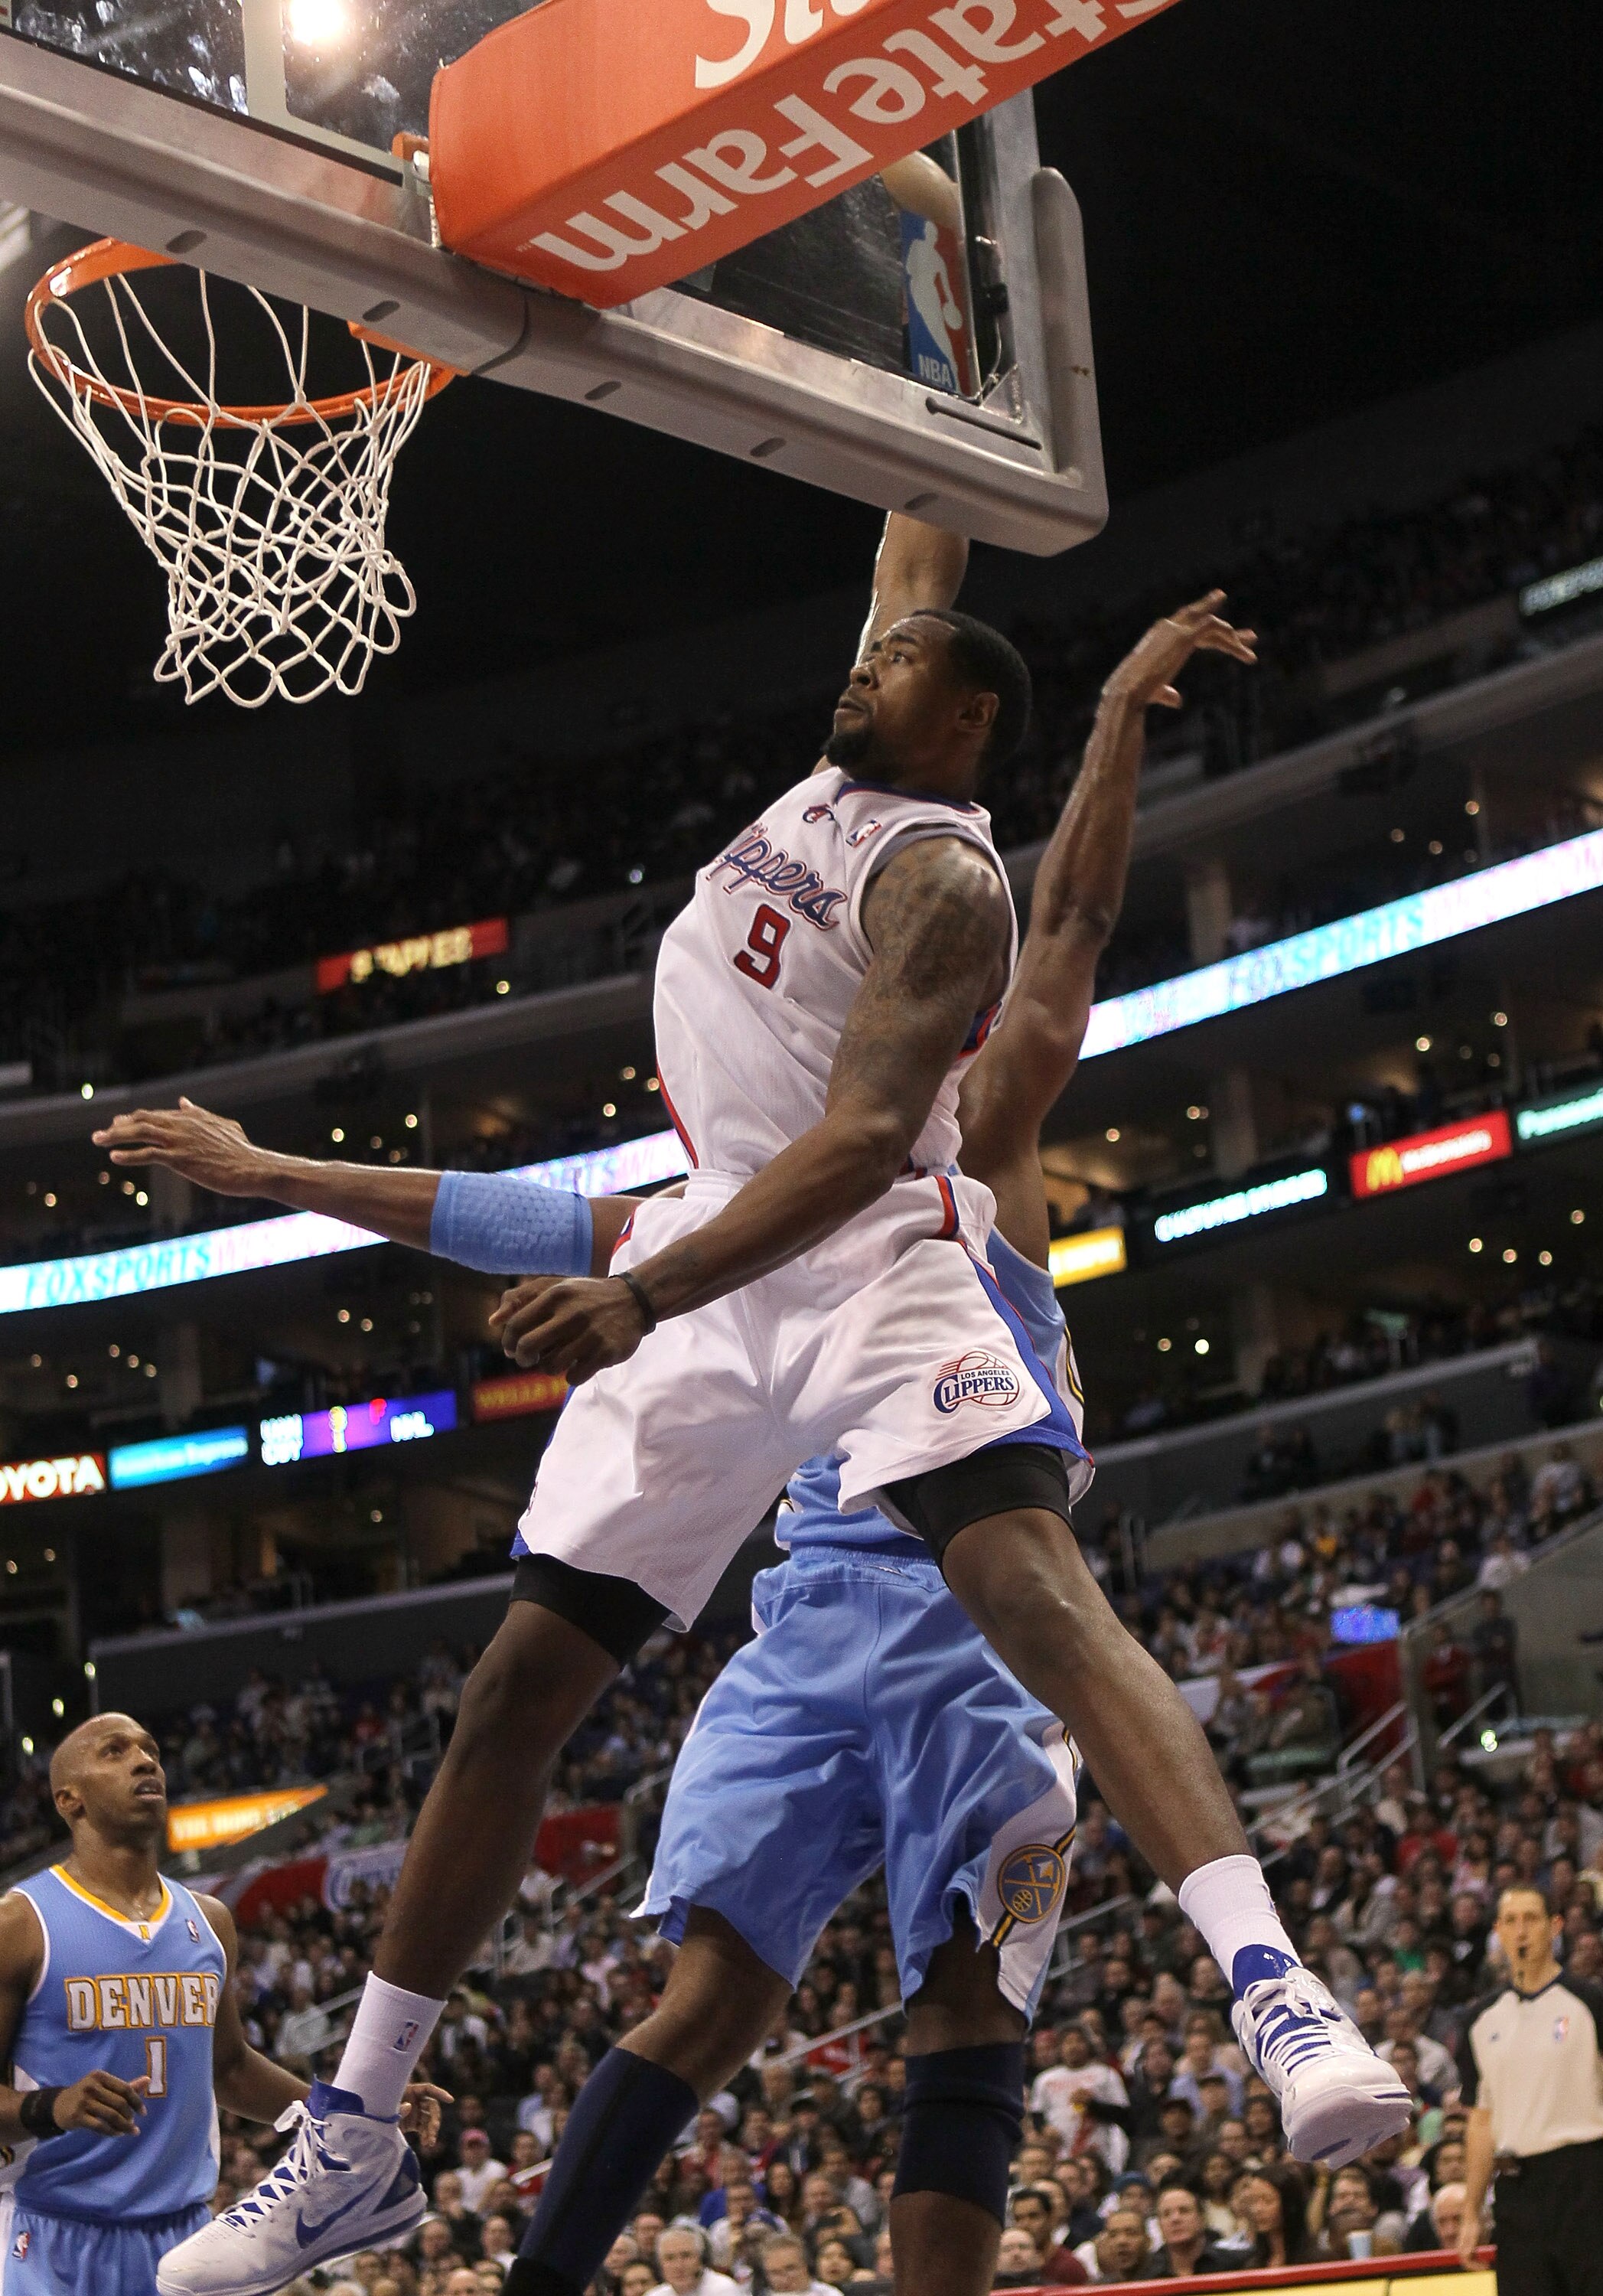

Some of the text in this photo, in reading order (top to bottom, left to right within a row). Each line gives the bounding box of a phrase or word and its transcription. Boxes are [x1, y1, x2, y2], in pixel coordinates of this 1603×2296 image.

[823, 0, 1175, 123] tate
[529, 93, 875, 272] Farm
[919, 353, 953, 390] NBA
[734, 903, 791, 990] 9
[933, 1375, 1014, 1414] CLIPPERS
[961, 1371, 976, 1380] LOS
[0, 1455, 105, 1502] YOTA
[64, 1971, 220, 2033] DENVER
[145, 2036, 168, 2099] 1
